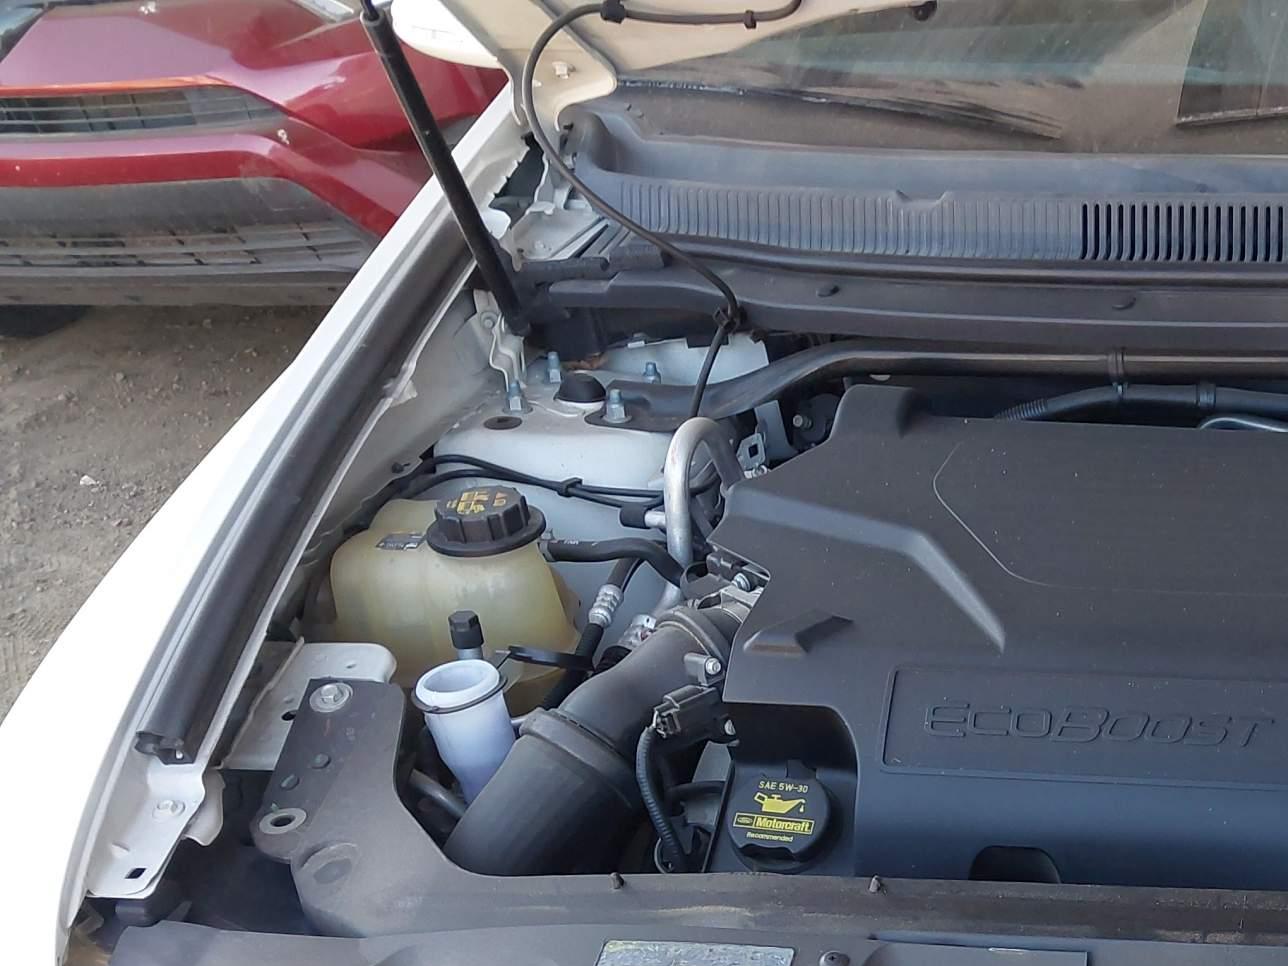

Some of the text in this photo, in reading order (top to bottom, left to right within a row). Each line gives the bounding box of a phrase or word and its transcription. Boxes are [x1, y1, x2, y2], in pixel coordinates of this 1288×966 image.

[758, 780, 809, 793] SAE 5W-30
[746, 831, 794, 842] Recommended
